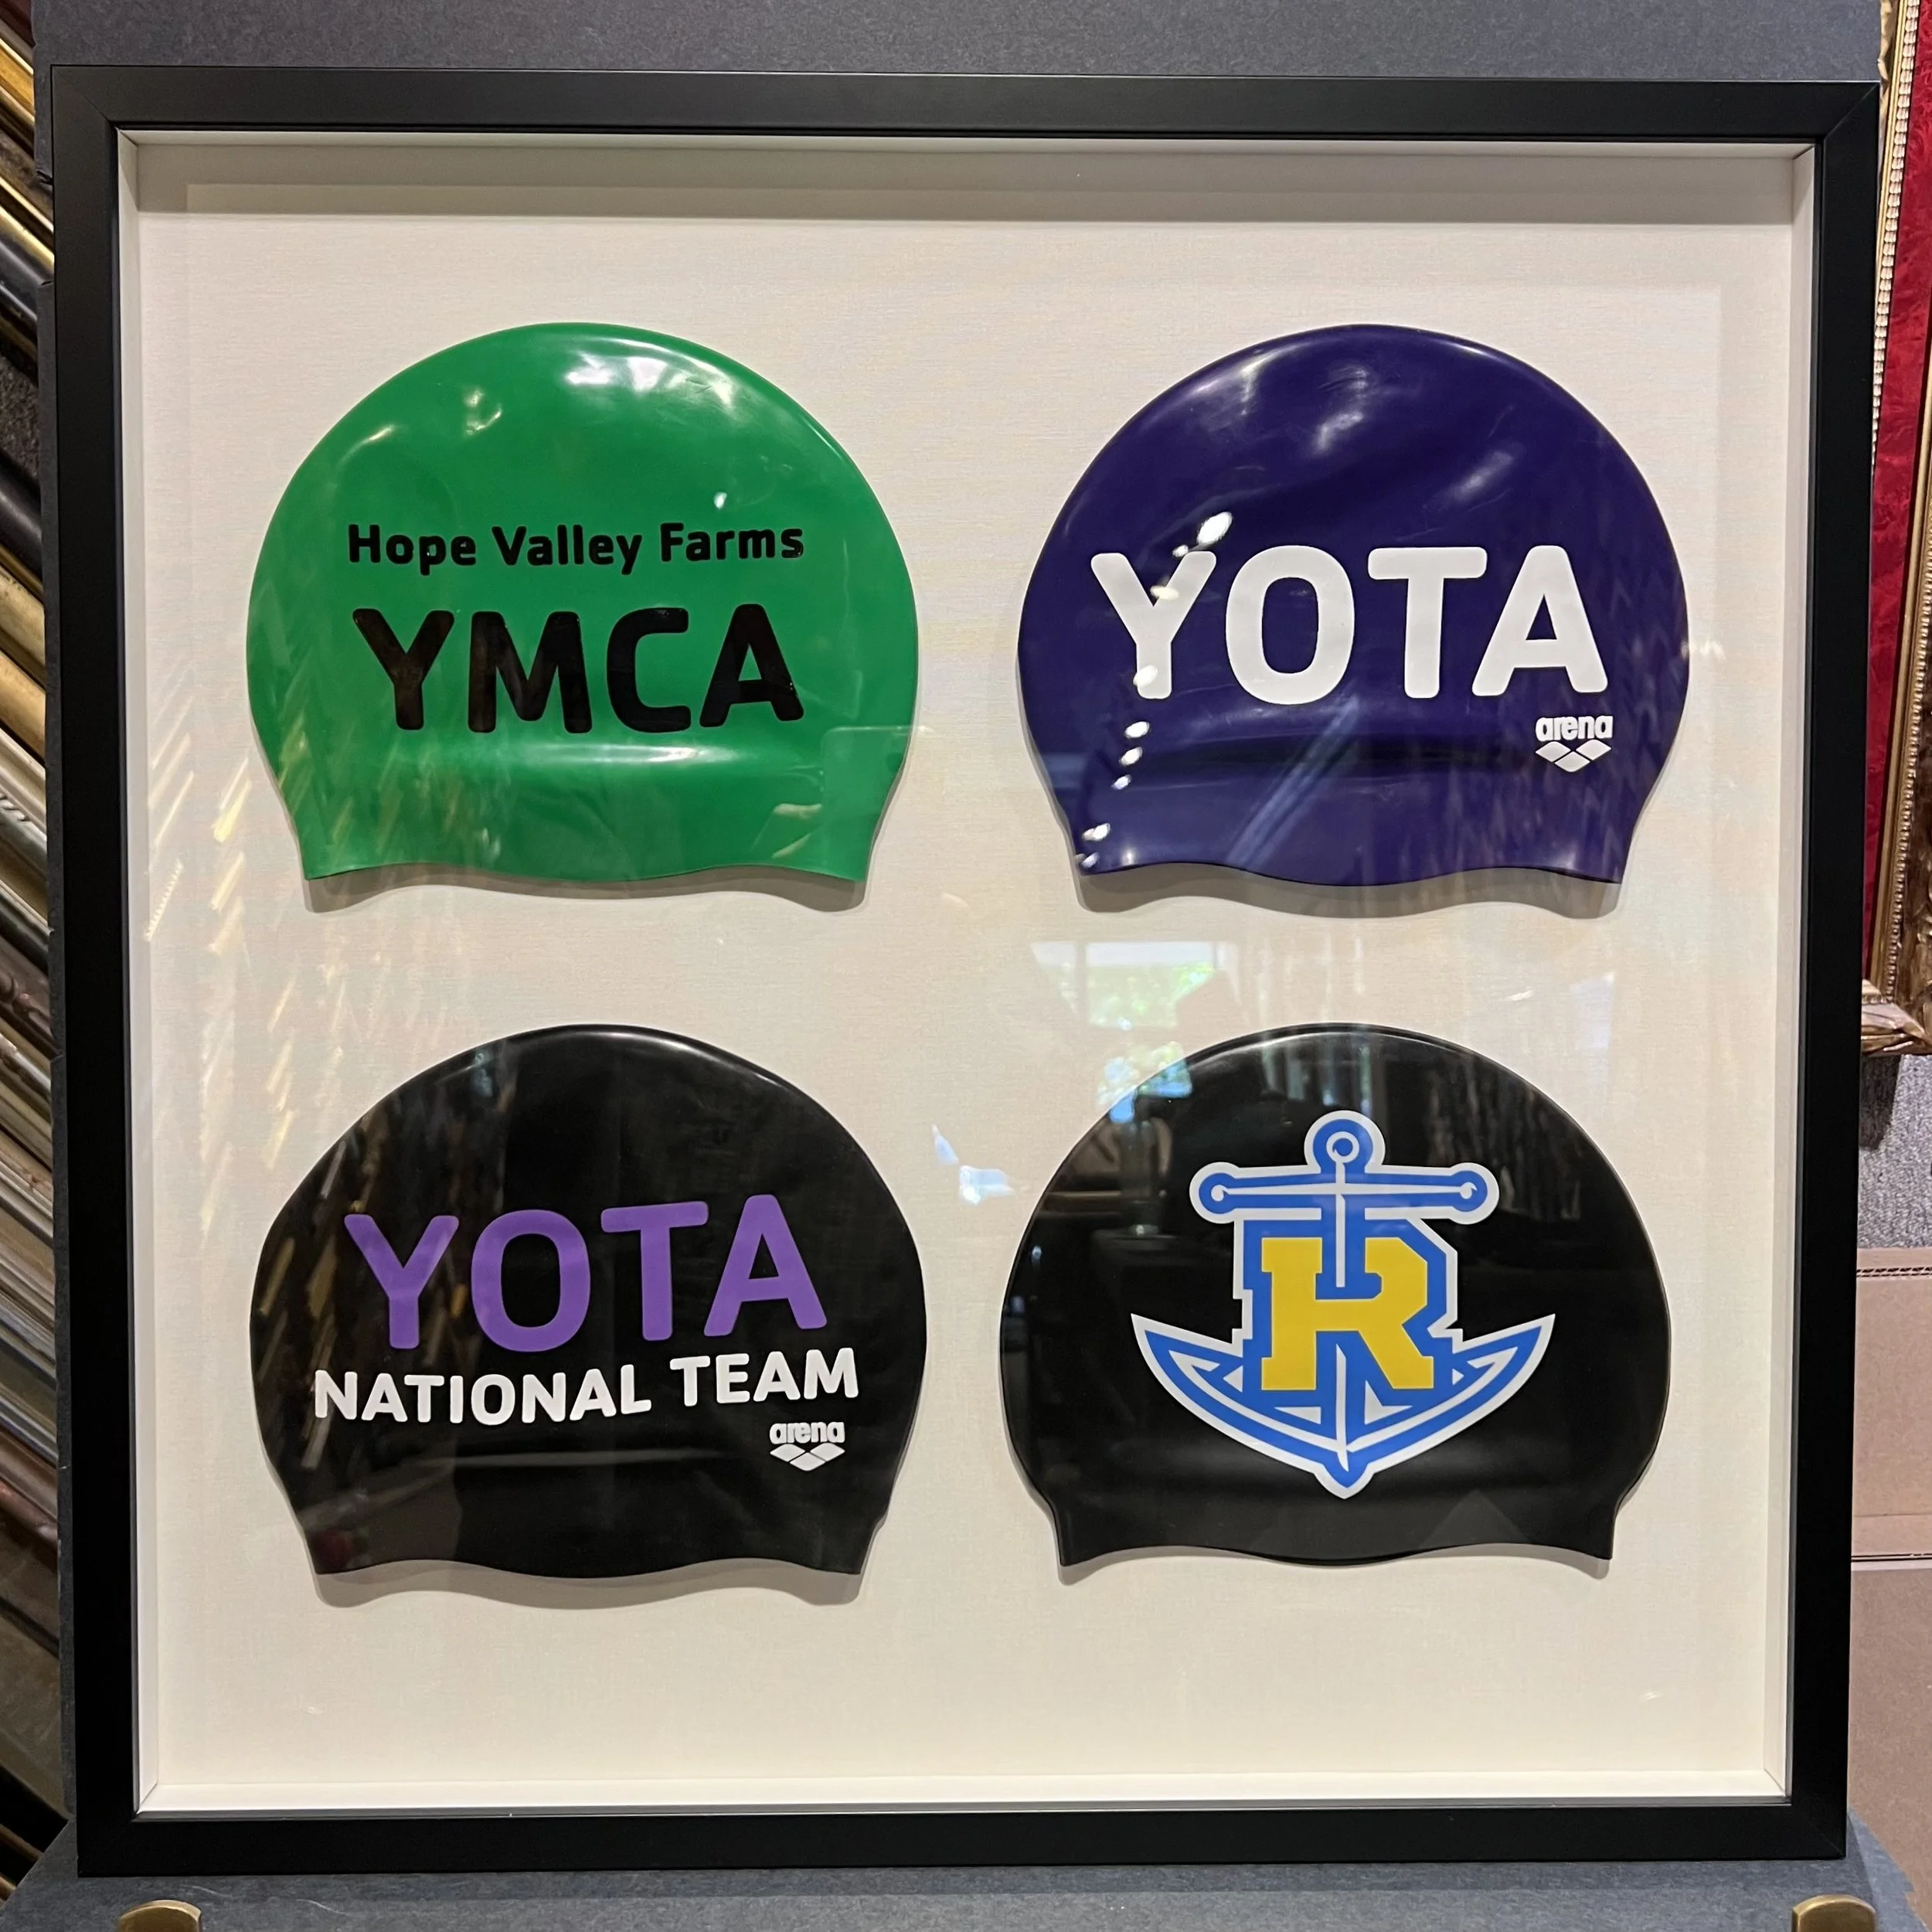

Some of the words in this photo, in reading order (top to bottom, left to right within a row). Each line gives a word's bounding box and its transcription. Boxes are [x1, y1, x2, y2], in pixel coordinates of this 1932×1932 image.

[348, 523, 476, 576] Hope
[492, 525, 642, 575] Valley
[660, 522, 804, 562] Farms
[1090, 545, 1608, 705] YOTA
[352, 604, 804, 733] YMCA
[1535, 714, 1614, 740] arena
[344, 1194, 828, 1352] YOTA
[315, 1364, 651, 1426] NATIONAL
[670, 1348, 859, 1406] TEAM
[769, 1420, 845, 1444] arena
